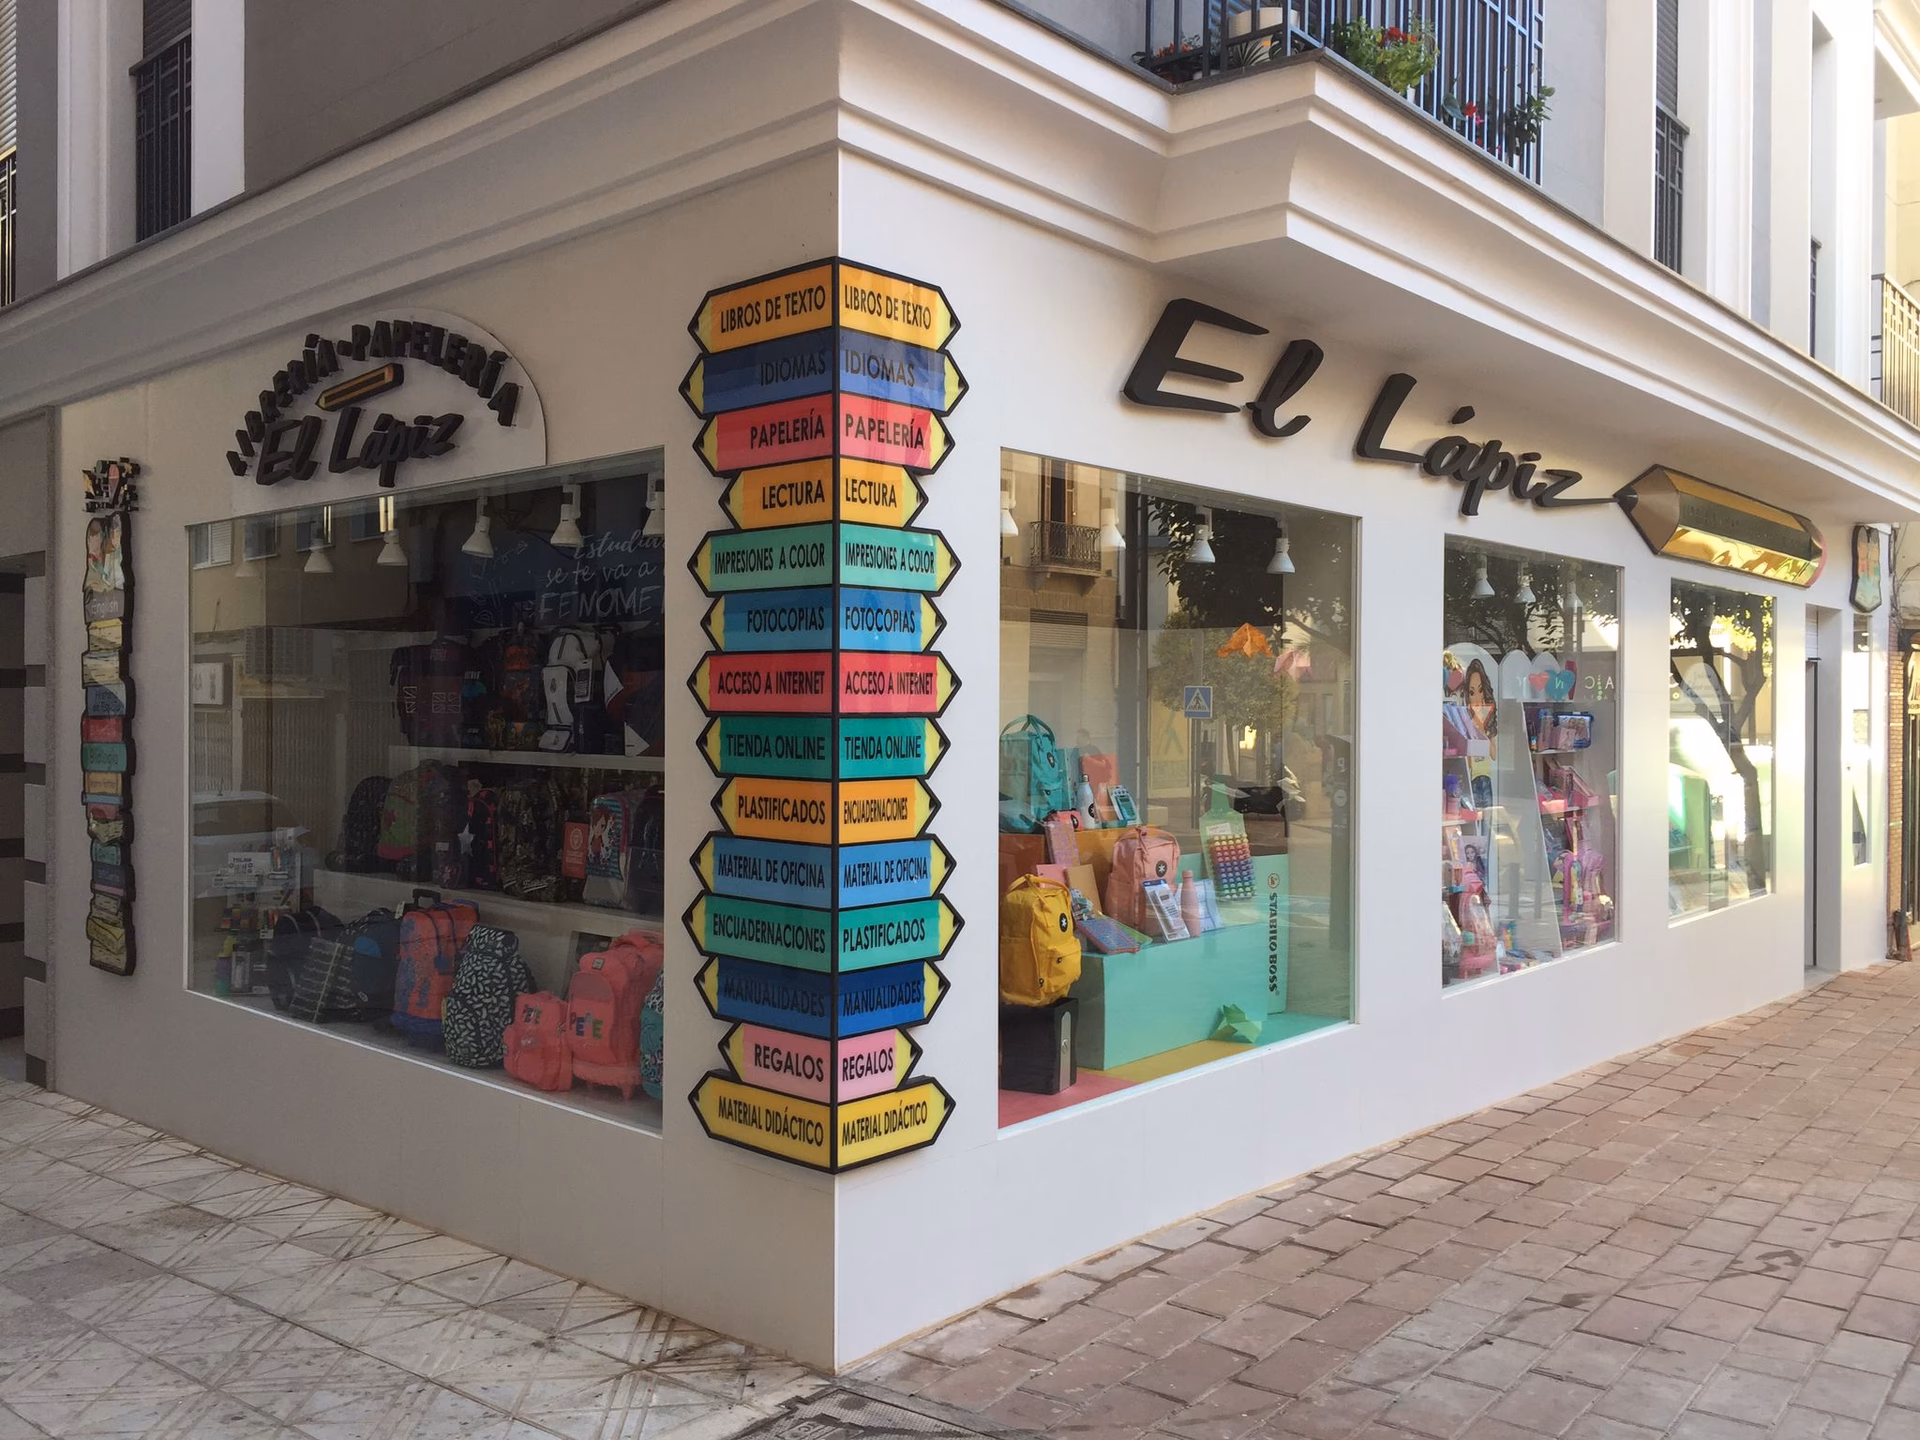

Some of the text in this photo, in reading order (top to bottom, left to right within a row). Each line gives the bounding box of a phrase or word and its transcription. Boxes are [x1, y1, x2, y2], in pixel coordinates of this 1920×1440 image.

[719, 285, 826, 334] LIBROS DE TEXTO
[844, 284, 932, 330] LIBROS DE TEXTO
[760, 352, 826, 386] IDIOMAS
[845, 348, 916, 388] IDIOMAS
[1121, 298, 1617, 516] El Lápiz
[750, 408, 826, 449] PAPELERÍA
[845, 414, 924, 450] PAPELERÍA
[256, 407, 464, 487] El Lápiz
[762, 479, 826, 509] LECTURA
[845, 477, 898, 508] LECTURA
[714, 543, 825, 575] IMPRESIONES A COLOR
[845, 542, 935, 574] IMPRESIONES A COLOR
[747, 607, 825, 633] FOTOCOPIAS
[845, 606, 915, 633] FOTOCOPIAS
[717, 670, 825, 695] ACCESO A INTERNET
[845, 671, 934, 695] ACCESO A INTERNET
[726, 733, 826, 760] TIENDA ONLINE
[844, 735, 922, 760] TIENDA ONLINE
[738, 795, 826, 825] PLASTIFICADOS
[844, 797, 908, 825] ENCUADERNACIONES
[718, 853, 825, 889] MATERIAL DE OFICINA
[843, 856, 928, 889] MATERIAL DE OFICINA
[713, 913, 825, 954] ENCUADERNACIONES
[843, 917, 926, 953] PLASTIFICADOS
[1268, 892, 1278, 951] STABILO
[724, 978, 825, 1018] MANUALIDADES
[843, 979, 922, 1017] MANUALIDADES
[754, 1044, 824, 1082] REGALOS
[842, 1047, 894, 1082] REGALOS
[718, 1096, 823, 1147] MATERIAL DIDÁCTICO
[842, 1101, 928, 1147] MATERIAL DIDÁCTICO
